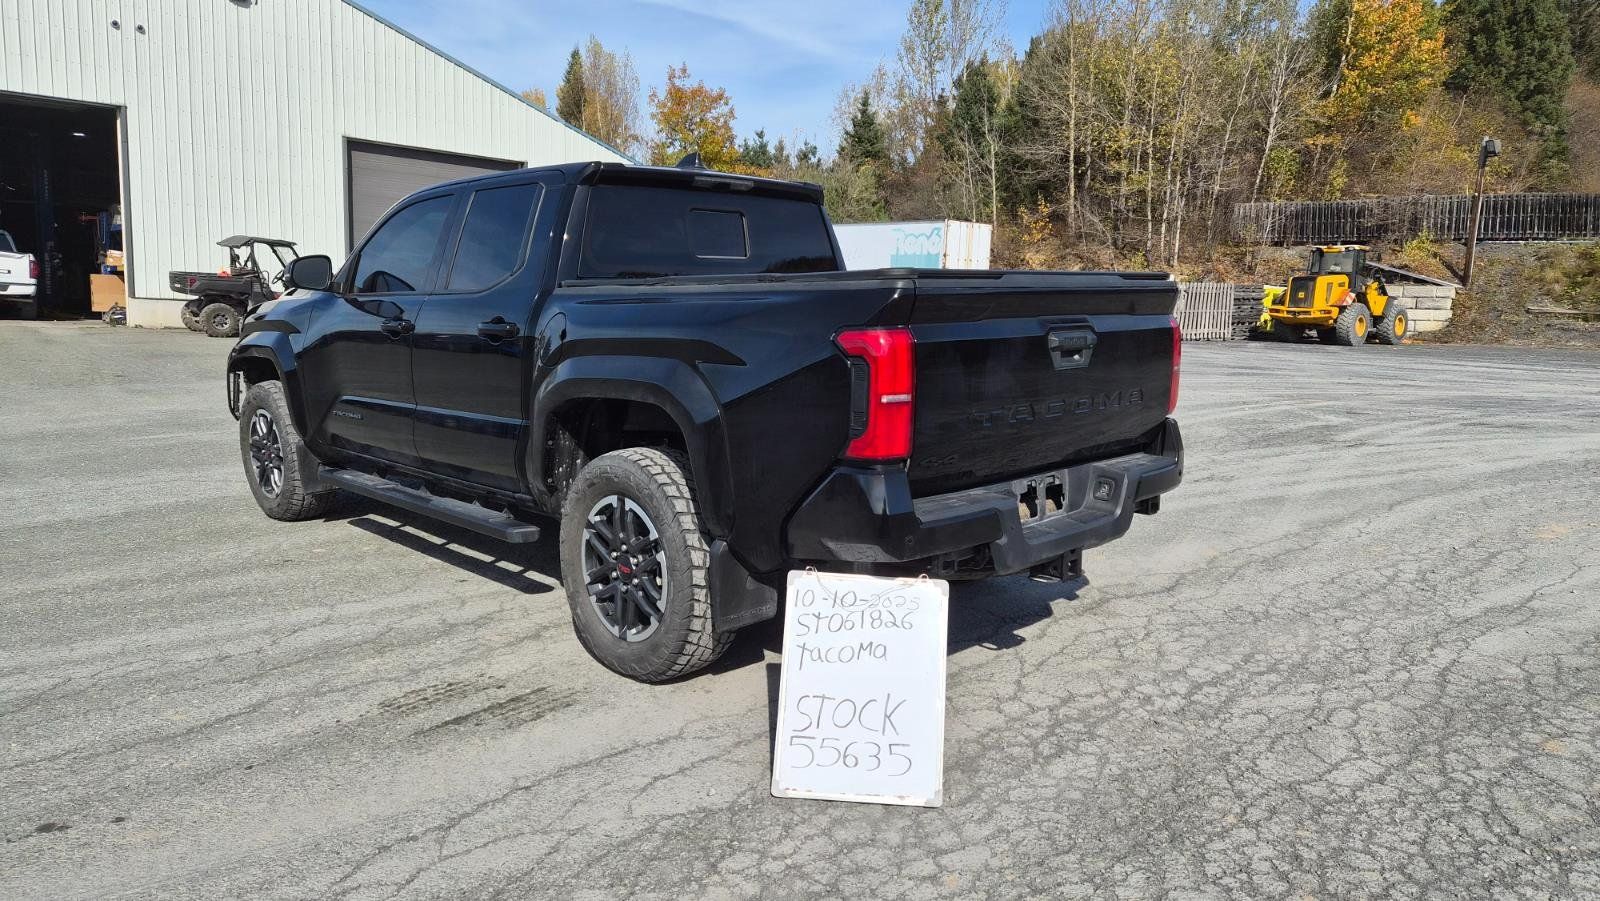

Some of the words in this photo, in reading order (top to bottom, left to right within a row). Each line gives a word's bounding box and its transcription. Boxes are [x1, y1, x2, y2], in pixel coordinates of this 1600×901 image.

[974, 387, 1145, 427] TACOMA
[792, 693, 907, 736] STOCK
[789, 735, 913, 777] 55635
